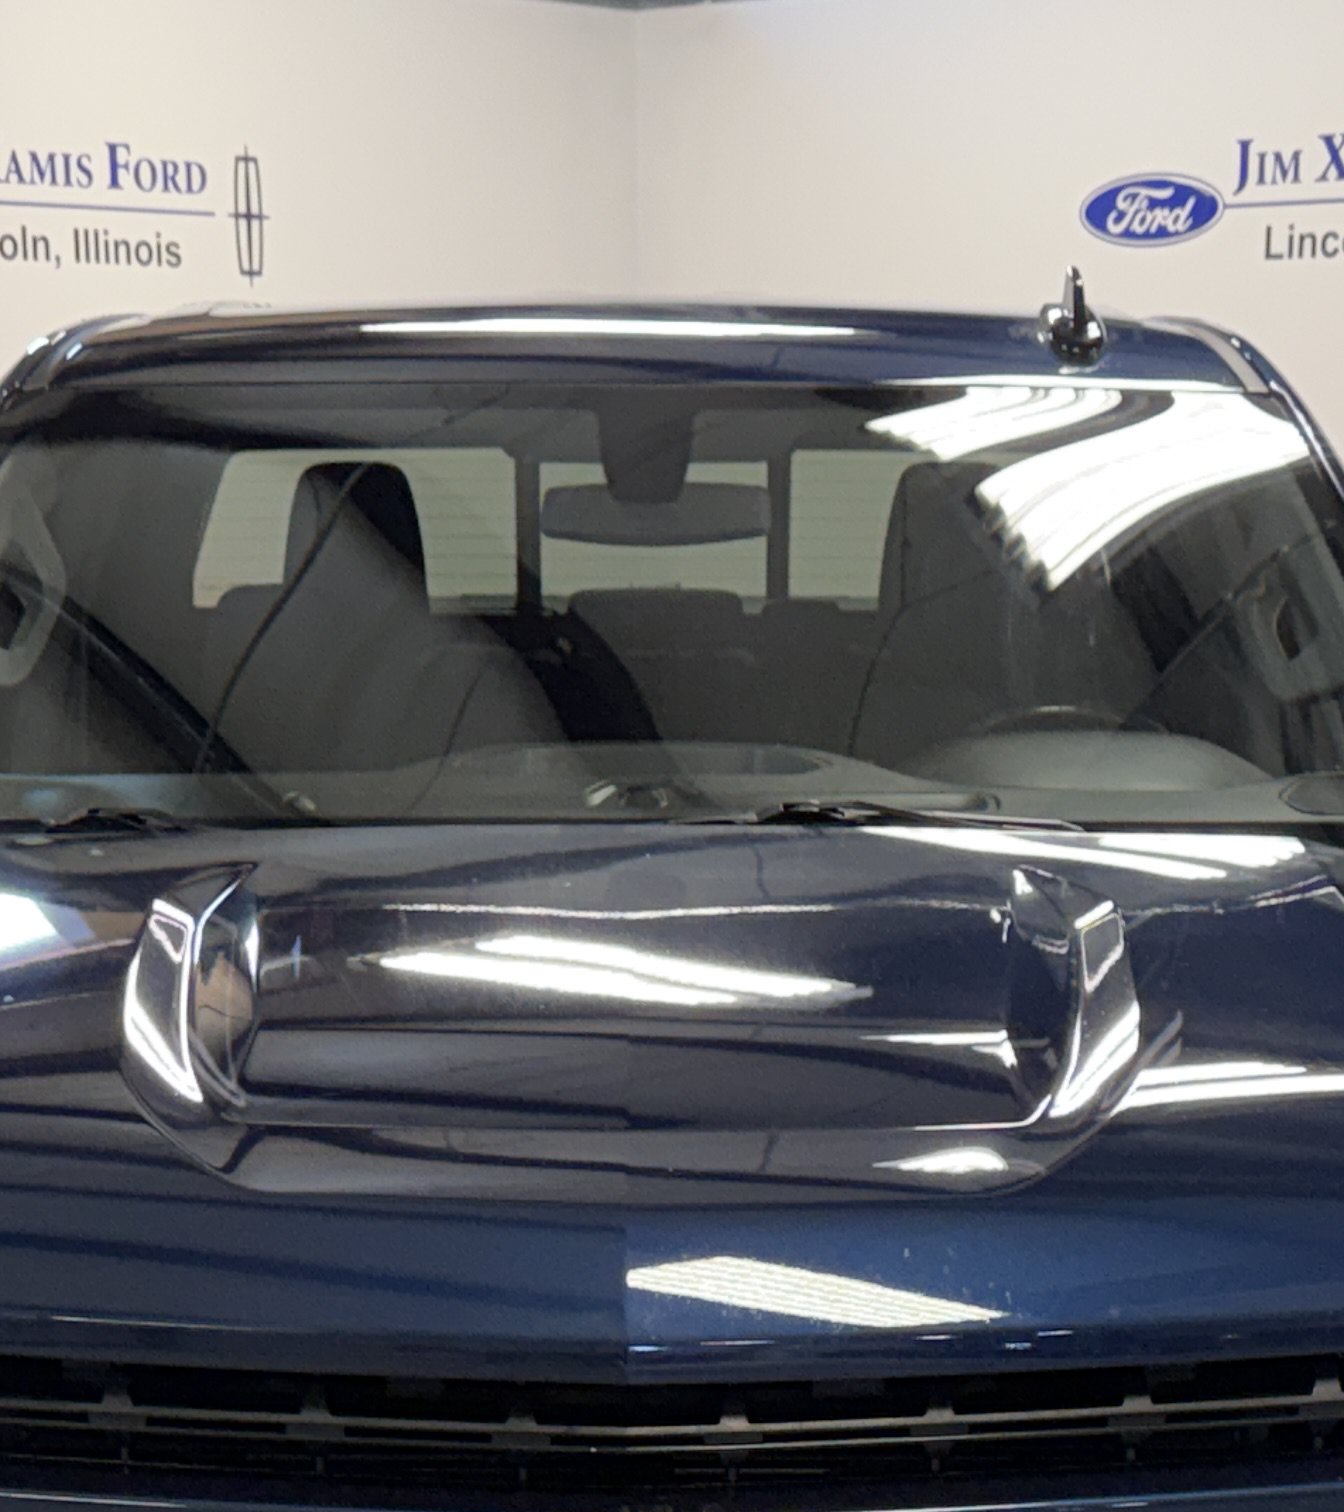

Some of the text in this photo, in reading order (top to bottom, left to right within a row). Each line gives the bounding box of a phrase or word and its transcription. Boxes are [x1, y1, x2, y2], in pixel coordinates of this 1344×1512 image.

[105, 141, 207, 195] FORD
[1233, 138, 1302, 195] JIM
[1105, 187, 1197, 235] Ford
[73, 228, 182, 268] Illinois
